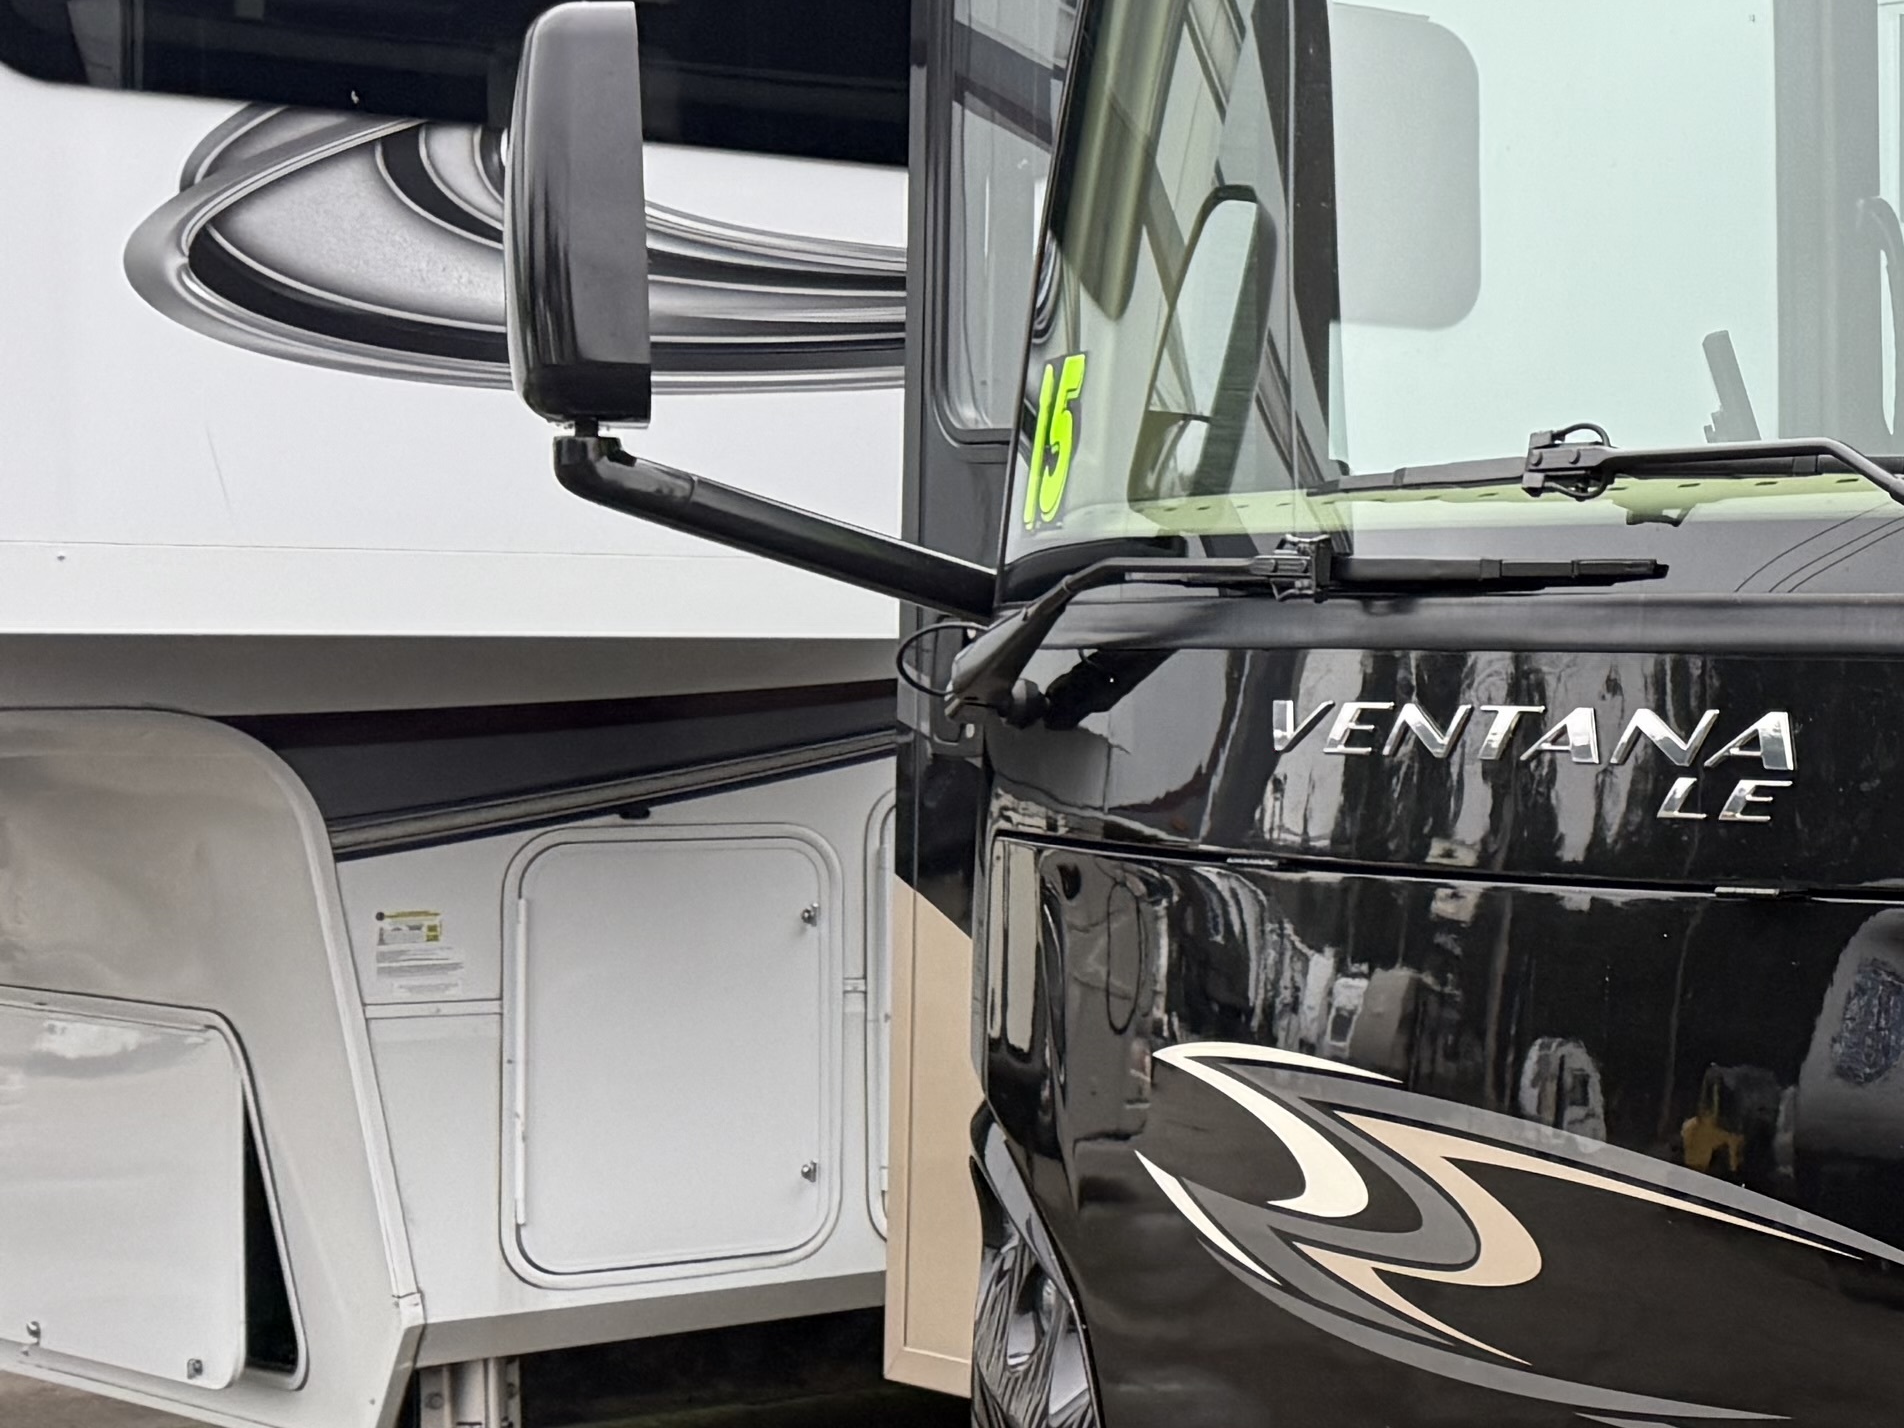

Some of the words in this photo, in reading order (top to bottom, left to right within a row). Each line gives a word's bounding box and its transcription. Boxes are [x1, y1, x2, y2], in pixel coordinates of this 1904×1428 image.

[1023, 354, 1086, 530] 15
[1271, 699, 1796, 771] VENTANA
[1656, 776, 1794, 822] LE
